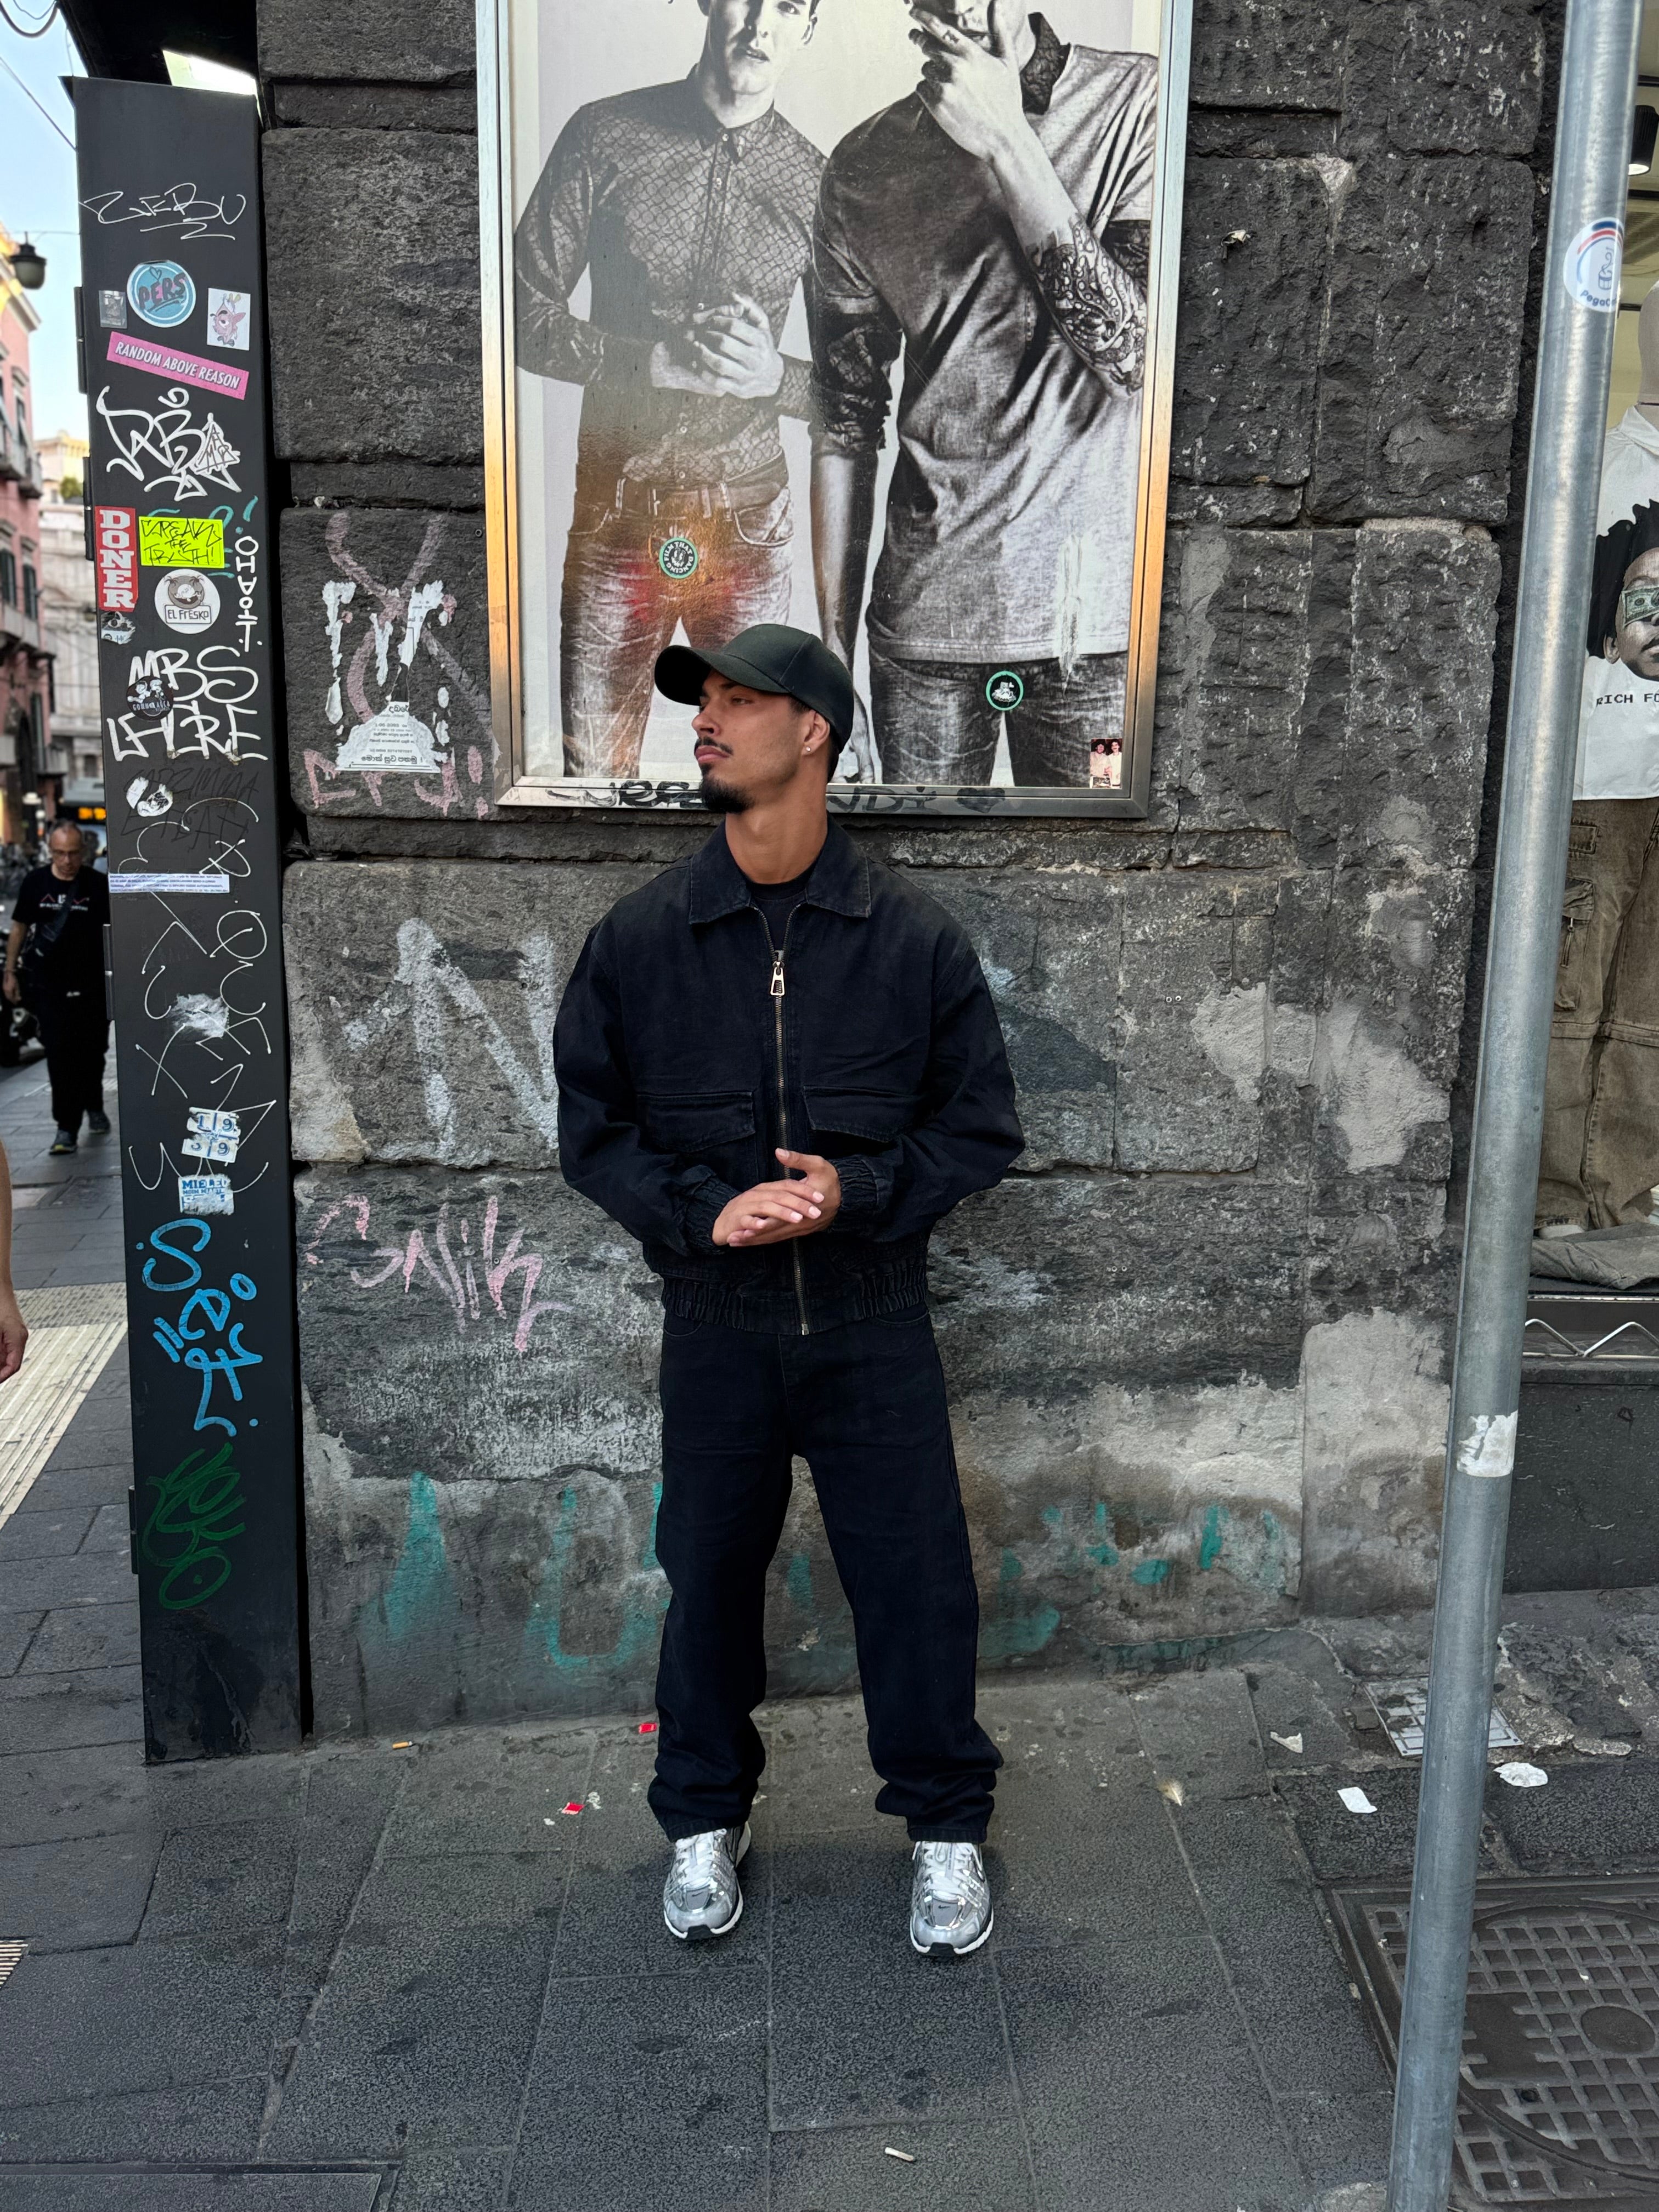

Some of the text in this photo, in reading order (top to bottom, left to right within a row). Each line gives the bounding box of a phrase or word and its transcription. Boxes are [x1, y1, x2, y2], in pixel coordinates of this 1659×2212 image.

[115, 341, 241, 390] RANDOM ABOVE REASON
[99, 510, 135, 608] DONER
[664, 541, 693, 574] FILM THAT DANCING
[167, 609, 177, 619] EL
[1596, 694, 1633, 707] RICH
